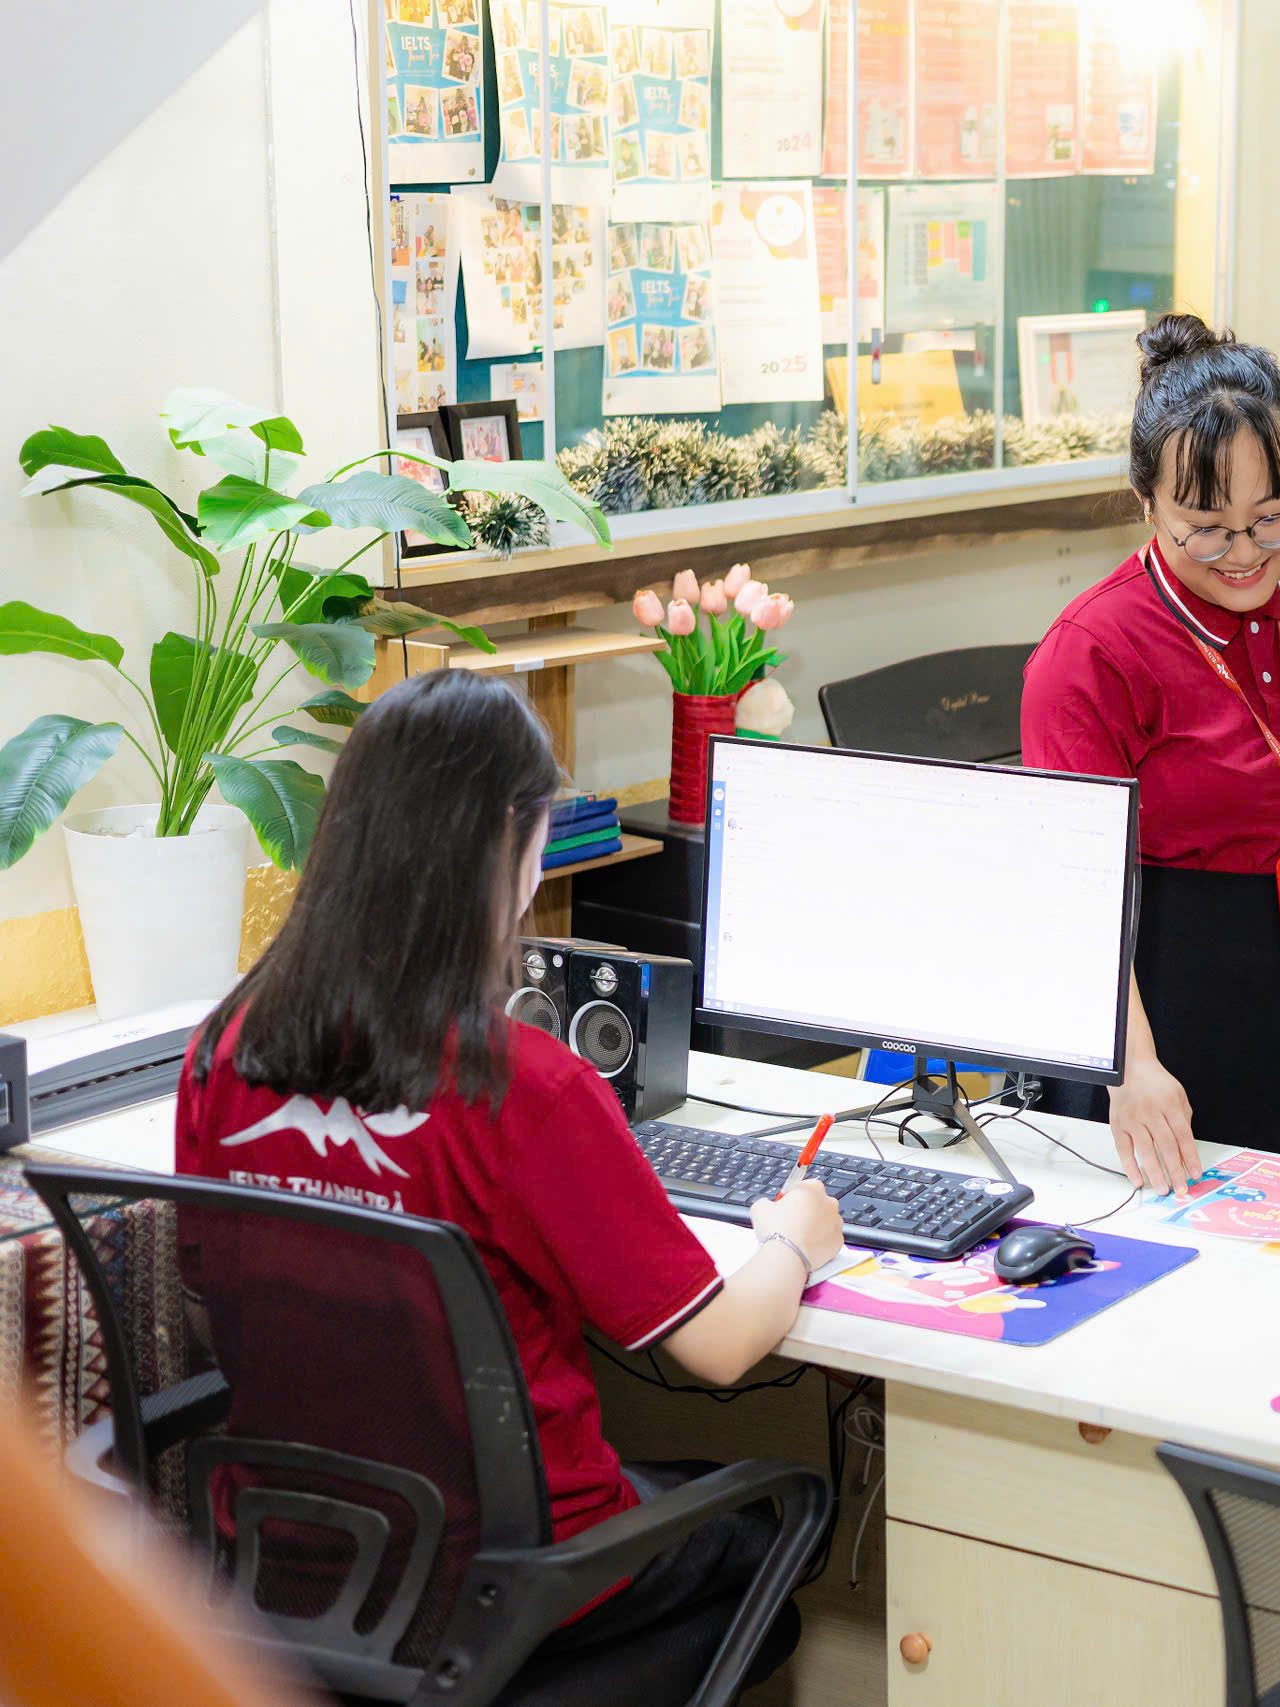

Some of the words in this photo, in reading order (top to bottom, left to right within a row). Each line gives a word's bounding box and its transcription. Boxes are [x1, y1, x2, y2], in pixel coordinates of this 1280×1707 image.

[761, 355, 809, 374] 2025
[882, 1041, 917, 1053] coocaa
[229, 1170, 282, 1191] IELTS
[286, 1177, 363, 1203] THANH
